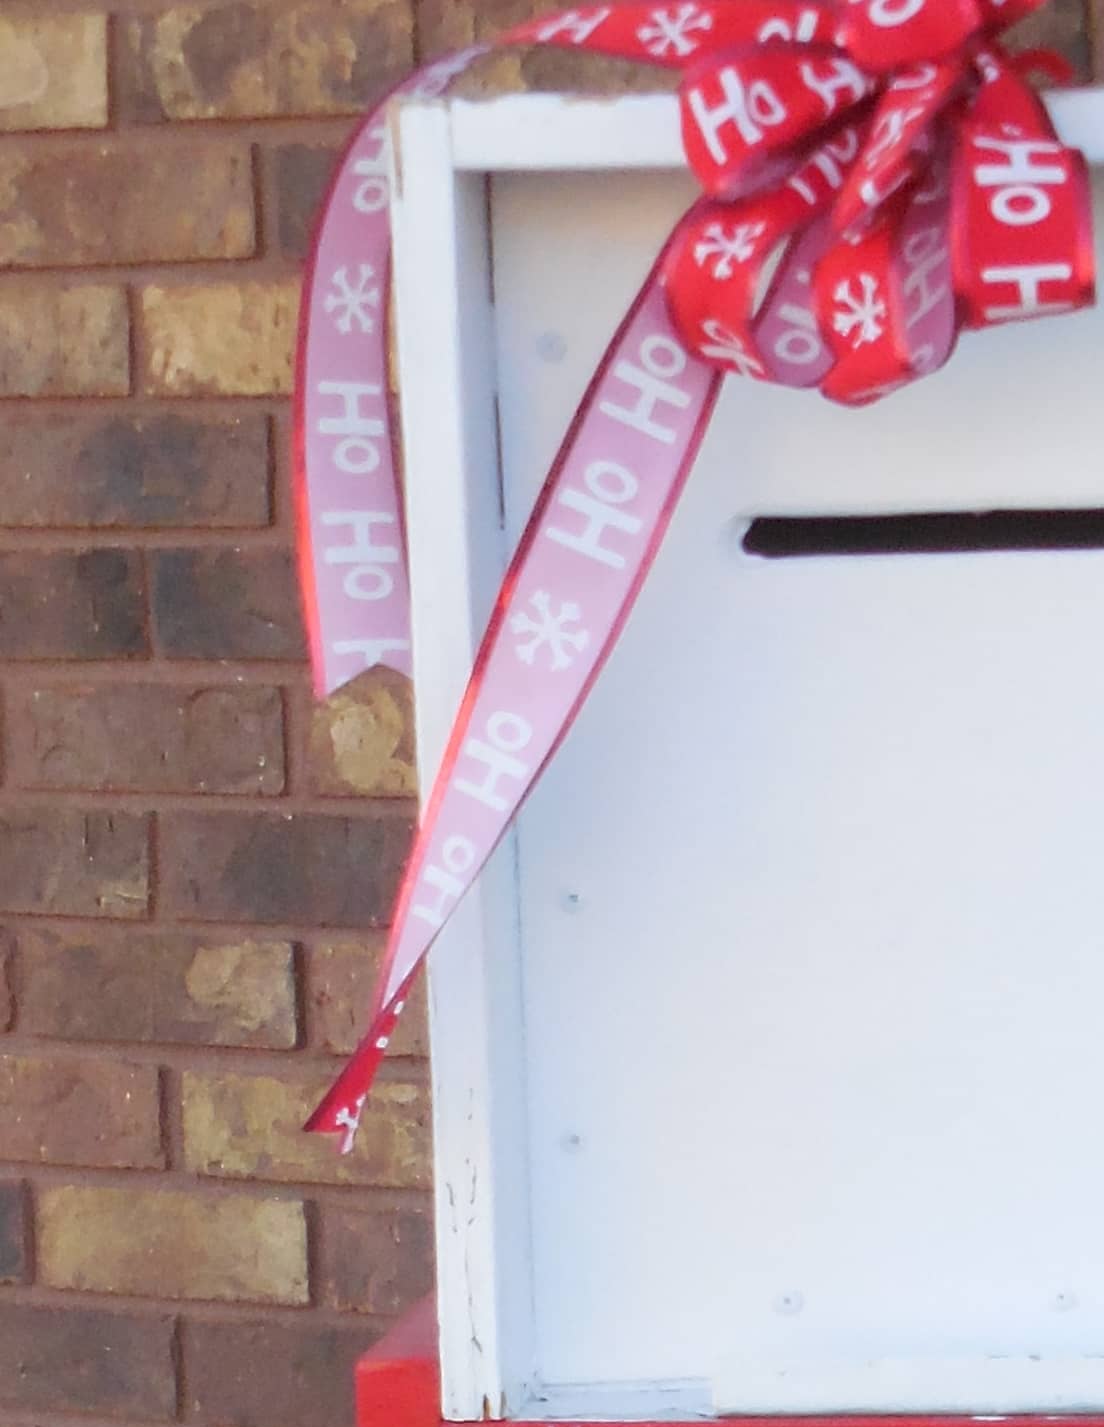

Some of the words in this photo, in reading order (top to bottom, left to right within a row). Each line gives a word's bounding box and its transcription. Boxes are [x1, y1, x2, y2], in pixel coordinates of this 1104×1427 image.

[690, 67, 787, 165] Ho
[973, 134, 1067, 226] Ho
[318, 381, 386, 474] Ho
[321, 510, 401, 600] Ho
[413, 836, 476, 927] Ho
[453, 711, 533, 812] Ho
[545, 459, 644, 570] Ho
[600, 334, 693, 445] Ho
